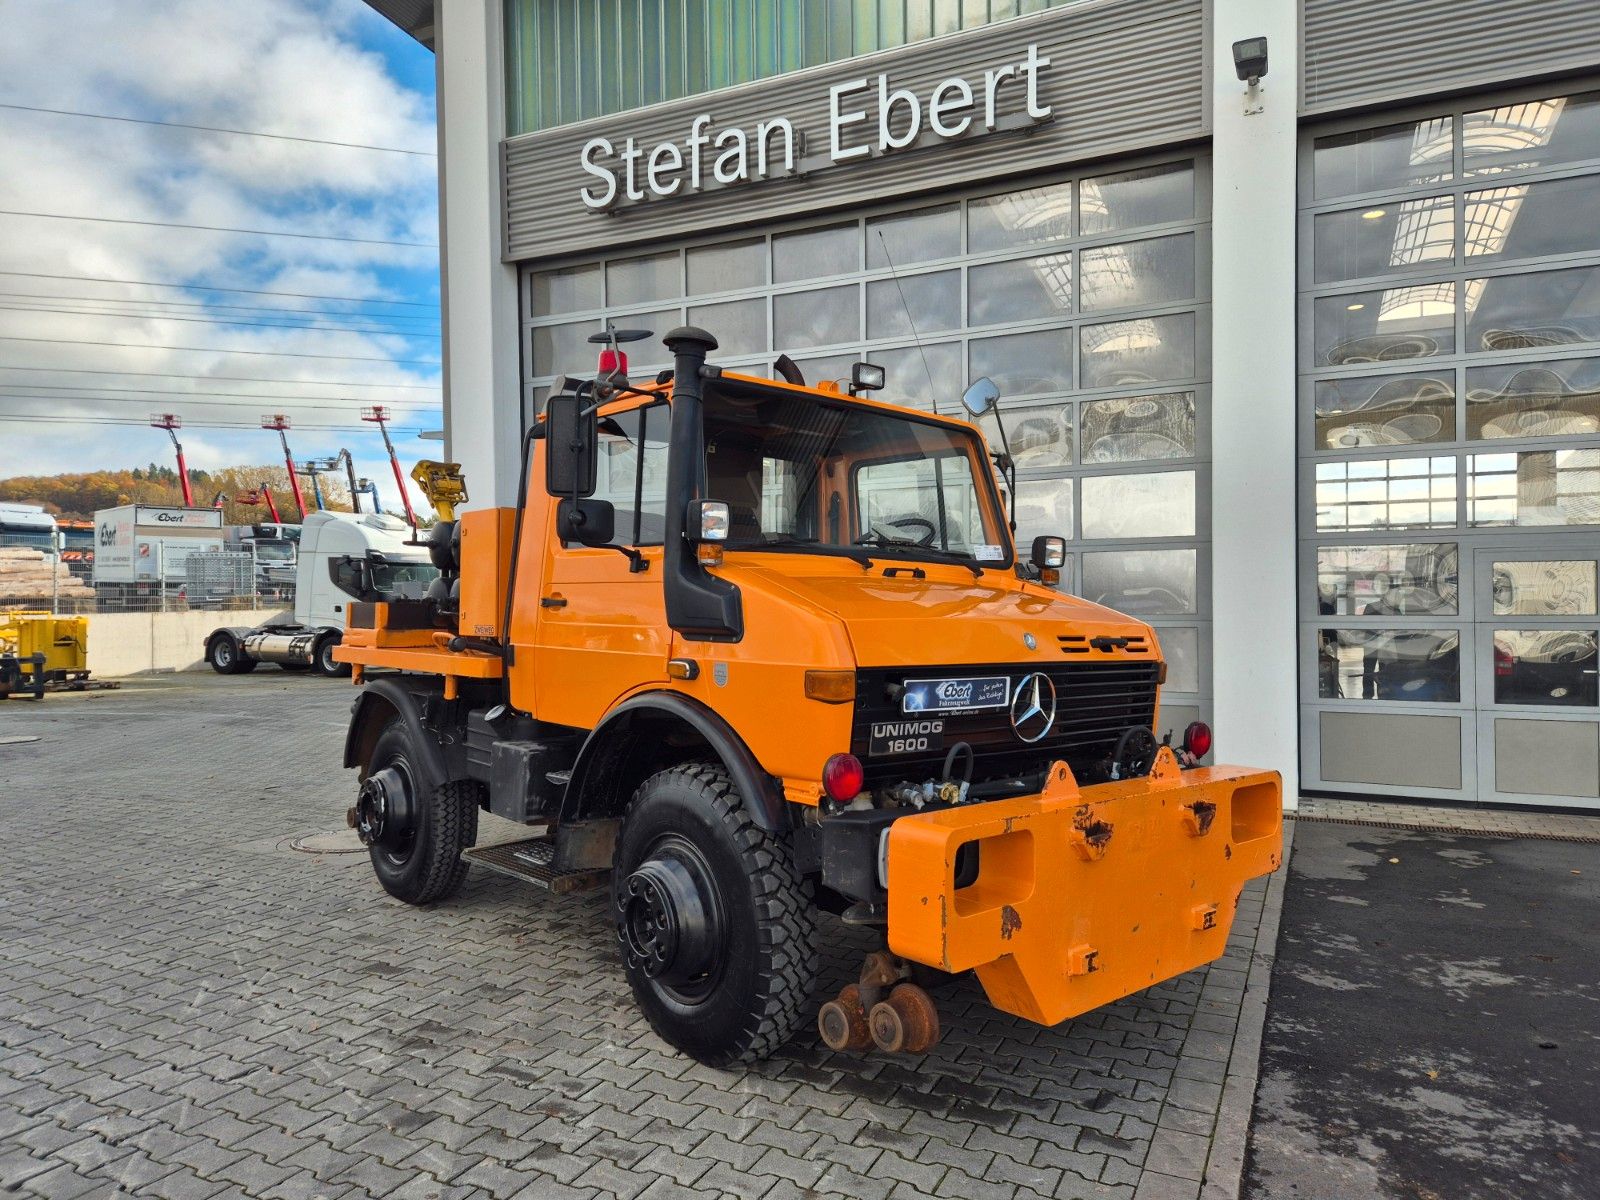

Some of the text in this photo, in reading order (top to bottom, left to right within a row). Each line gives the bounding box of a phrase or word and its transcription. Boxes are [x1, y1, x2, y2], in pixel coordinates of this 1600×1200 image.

[580, 44, 1052, 210] Stefan Ebert
[157, 513, 184, 522] Ebert
[943, 682, 973, 698] Ebert
[874, 721, 943, 738] UNIMOG
[887, 737, 928, 753] 1600
